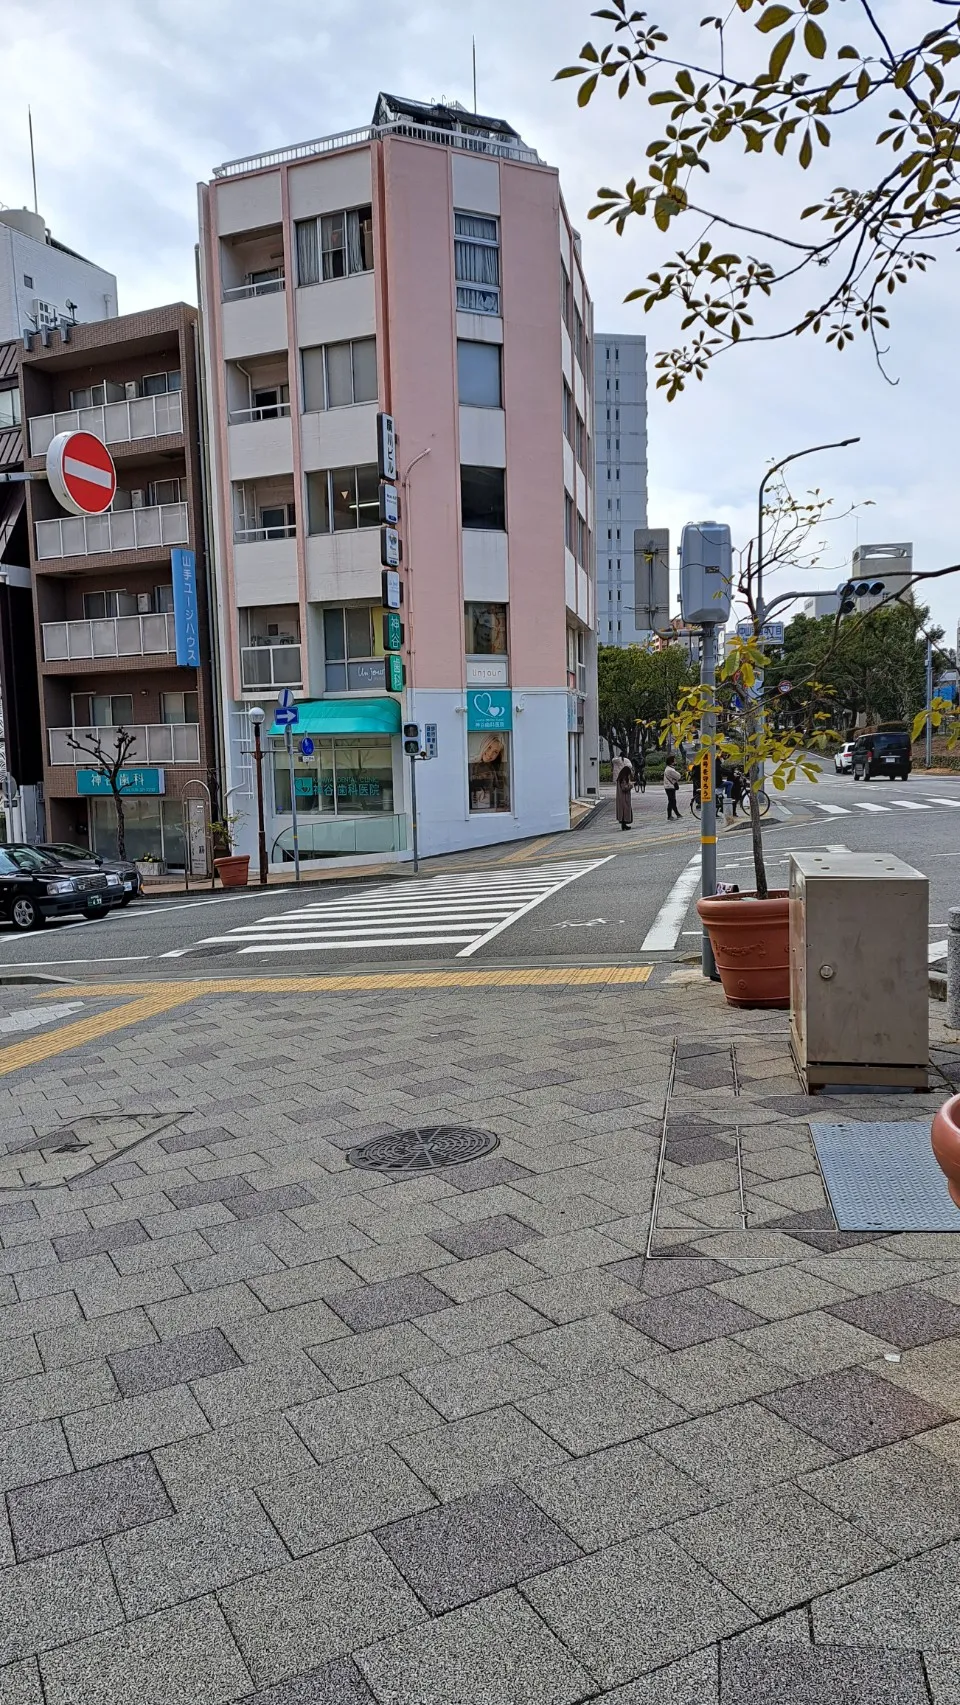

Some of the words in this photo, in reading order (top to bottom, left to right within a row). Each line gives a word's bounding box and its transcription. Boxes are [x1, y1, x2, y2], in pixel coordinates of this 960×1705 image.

[182, 555, 197, 661] 山手ユージハウス
[391, 615, 399, 648] 神谷
[91, 773, 144, 787] 神歯科
